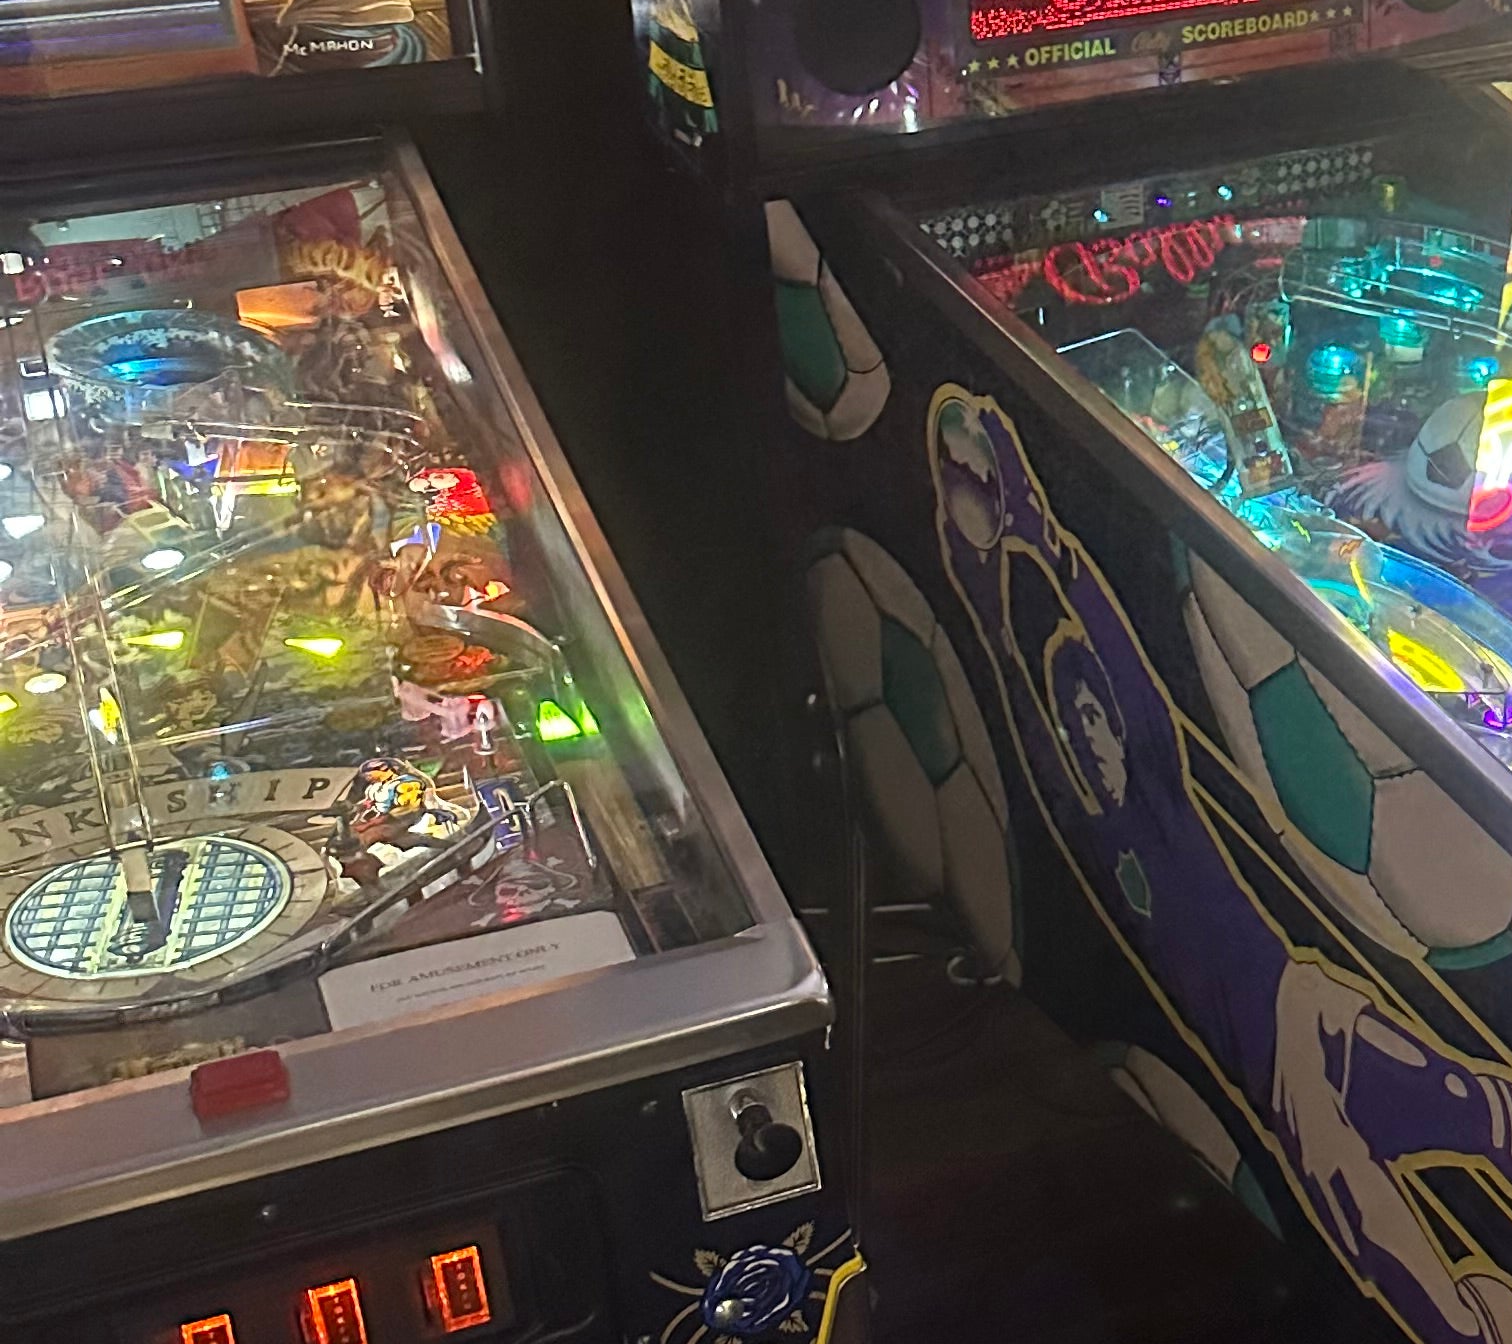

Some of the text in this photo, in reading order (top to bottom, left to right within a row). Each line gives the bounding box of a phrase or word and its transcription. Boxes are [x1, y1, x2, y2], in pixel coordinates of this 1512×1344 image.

[1024, 37, 1117, 67] OFFICIAL
[1181, 9, 1310, 44] SCOREBOARD
[370, 978, 402, 994] FOR
[408, 950, 513, 985] AMUSEMENT
[515, 941, 561, 960] ONLY
